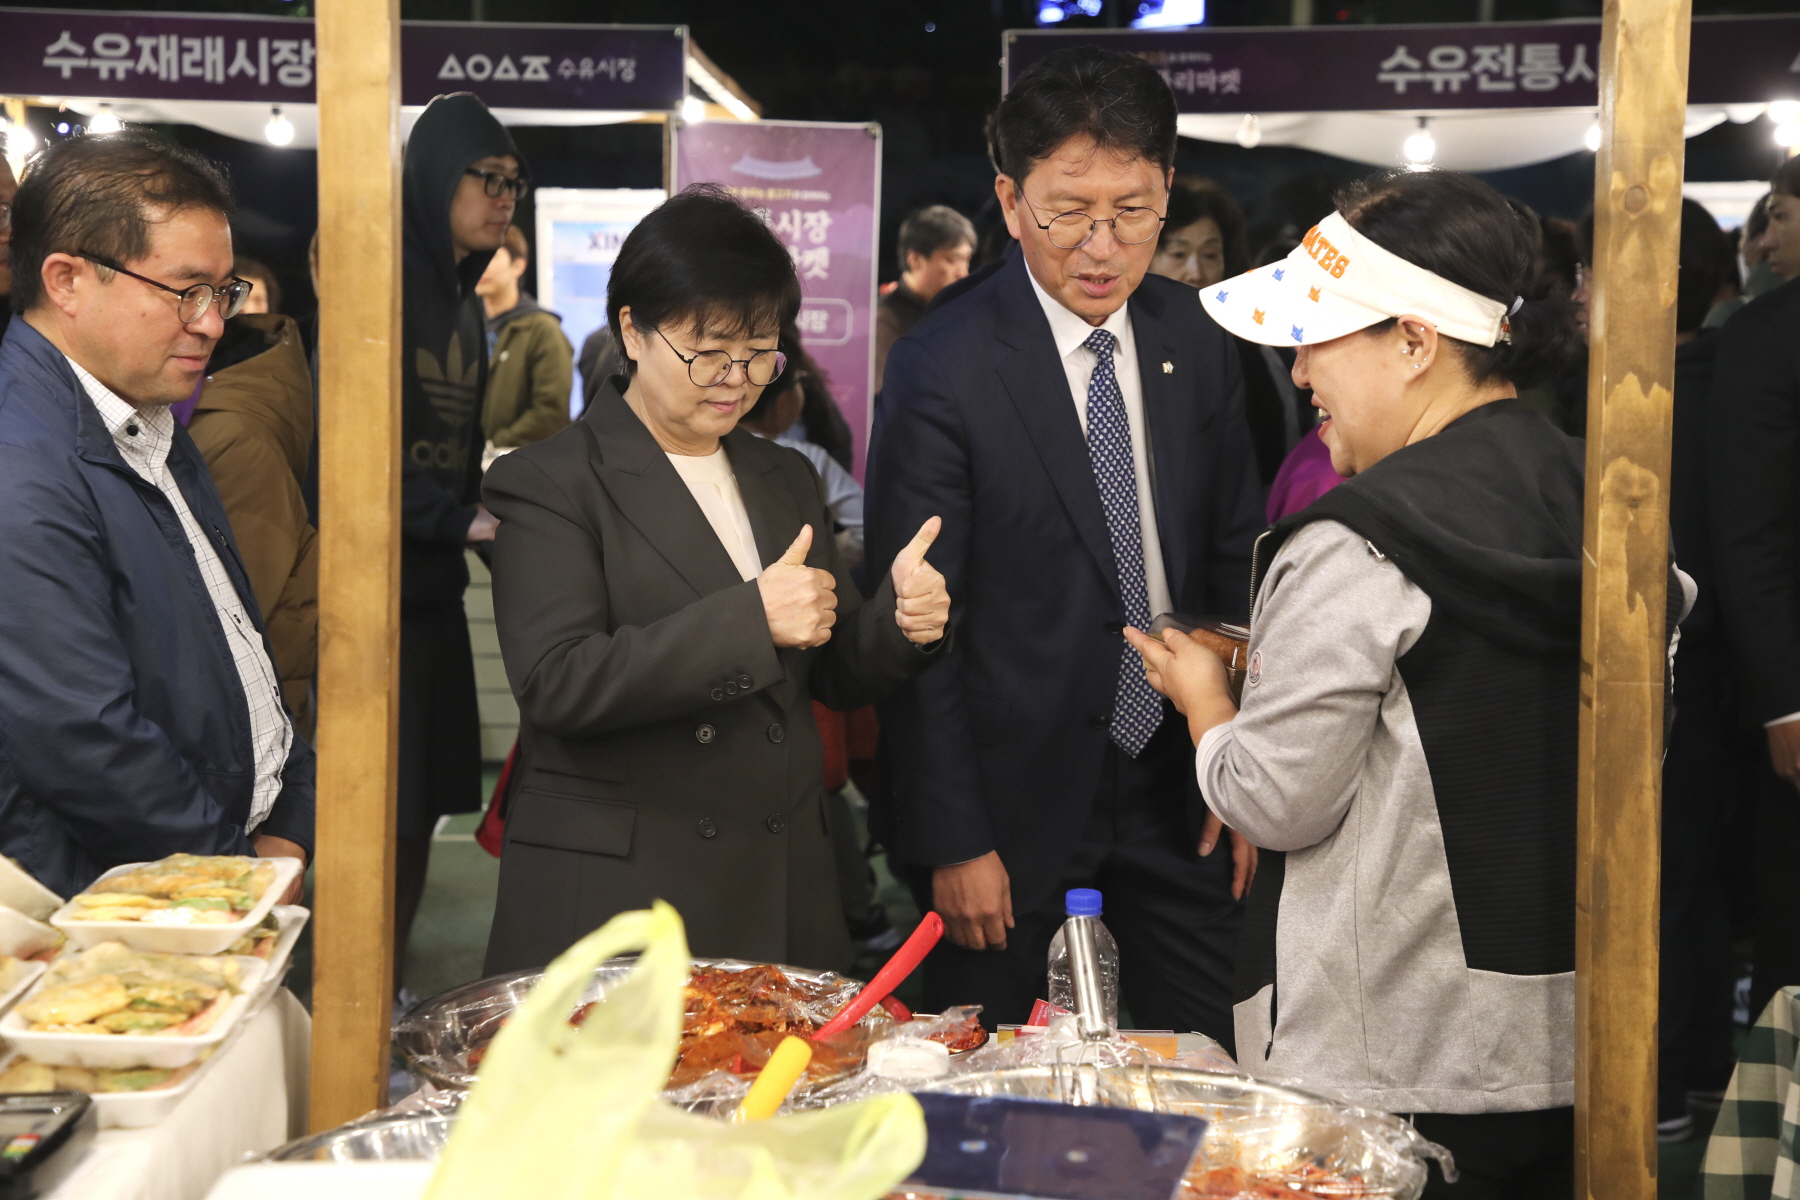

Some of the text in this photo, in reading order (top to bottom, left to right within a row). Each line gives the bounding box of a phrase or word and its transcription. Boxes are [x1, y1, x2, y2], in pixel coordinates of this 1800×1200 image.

[43, 31, 317, 87] 수유재래시장
[556, 57, 637, 83] 수유시장
[752, 206, 833, 244] 시장
